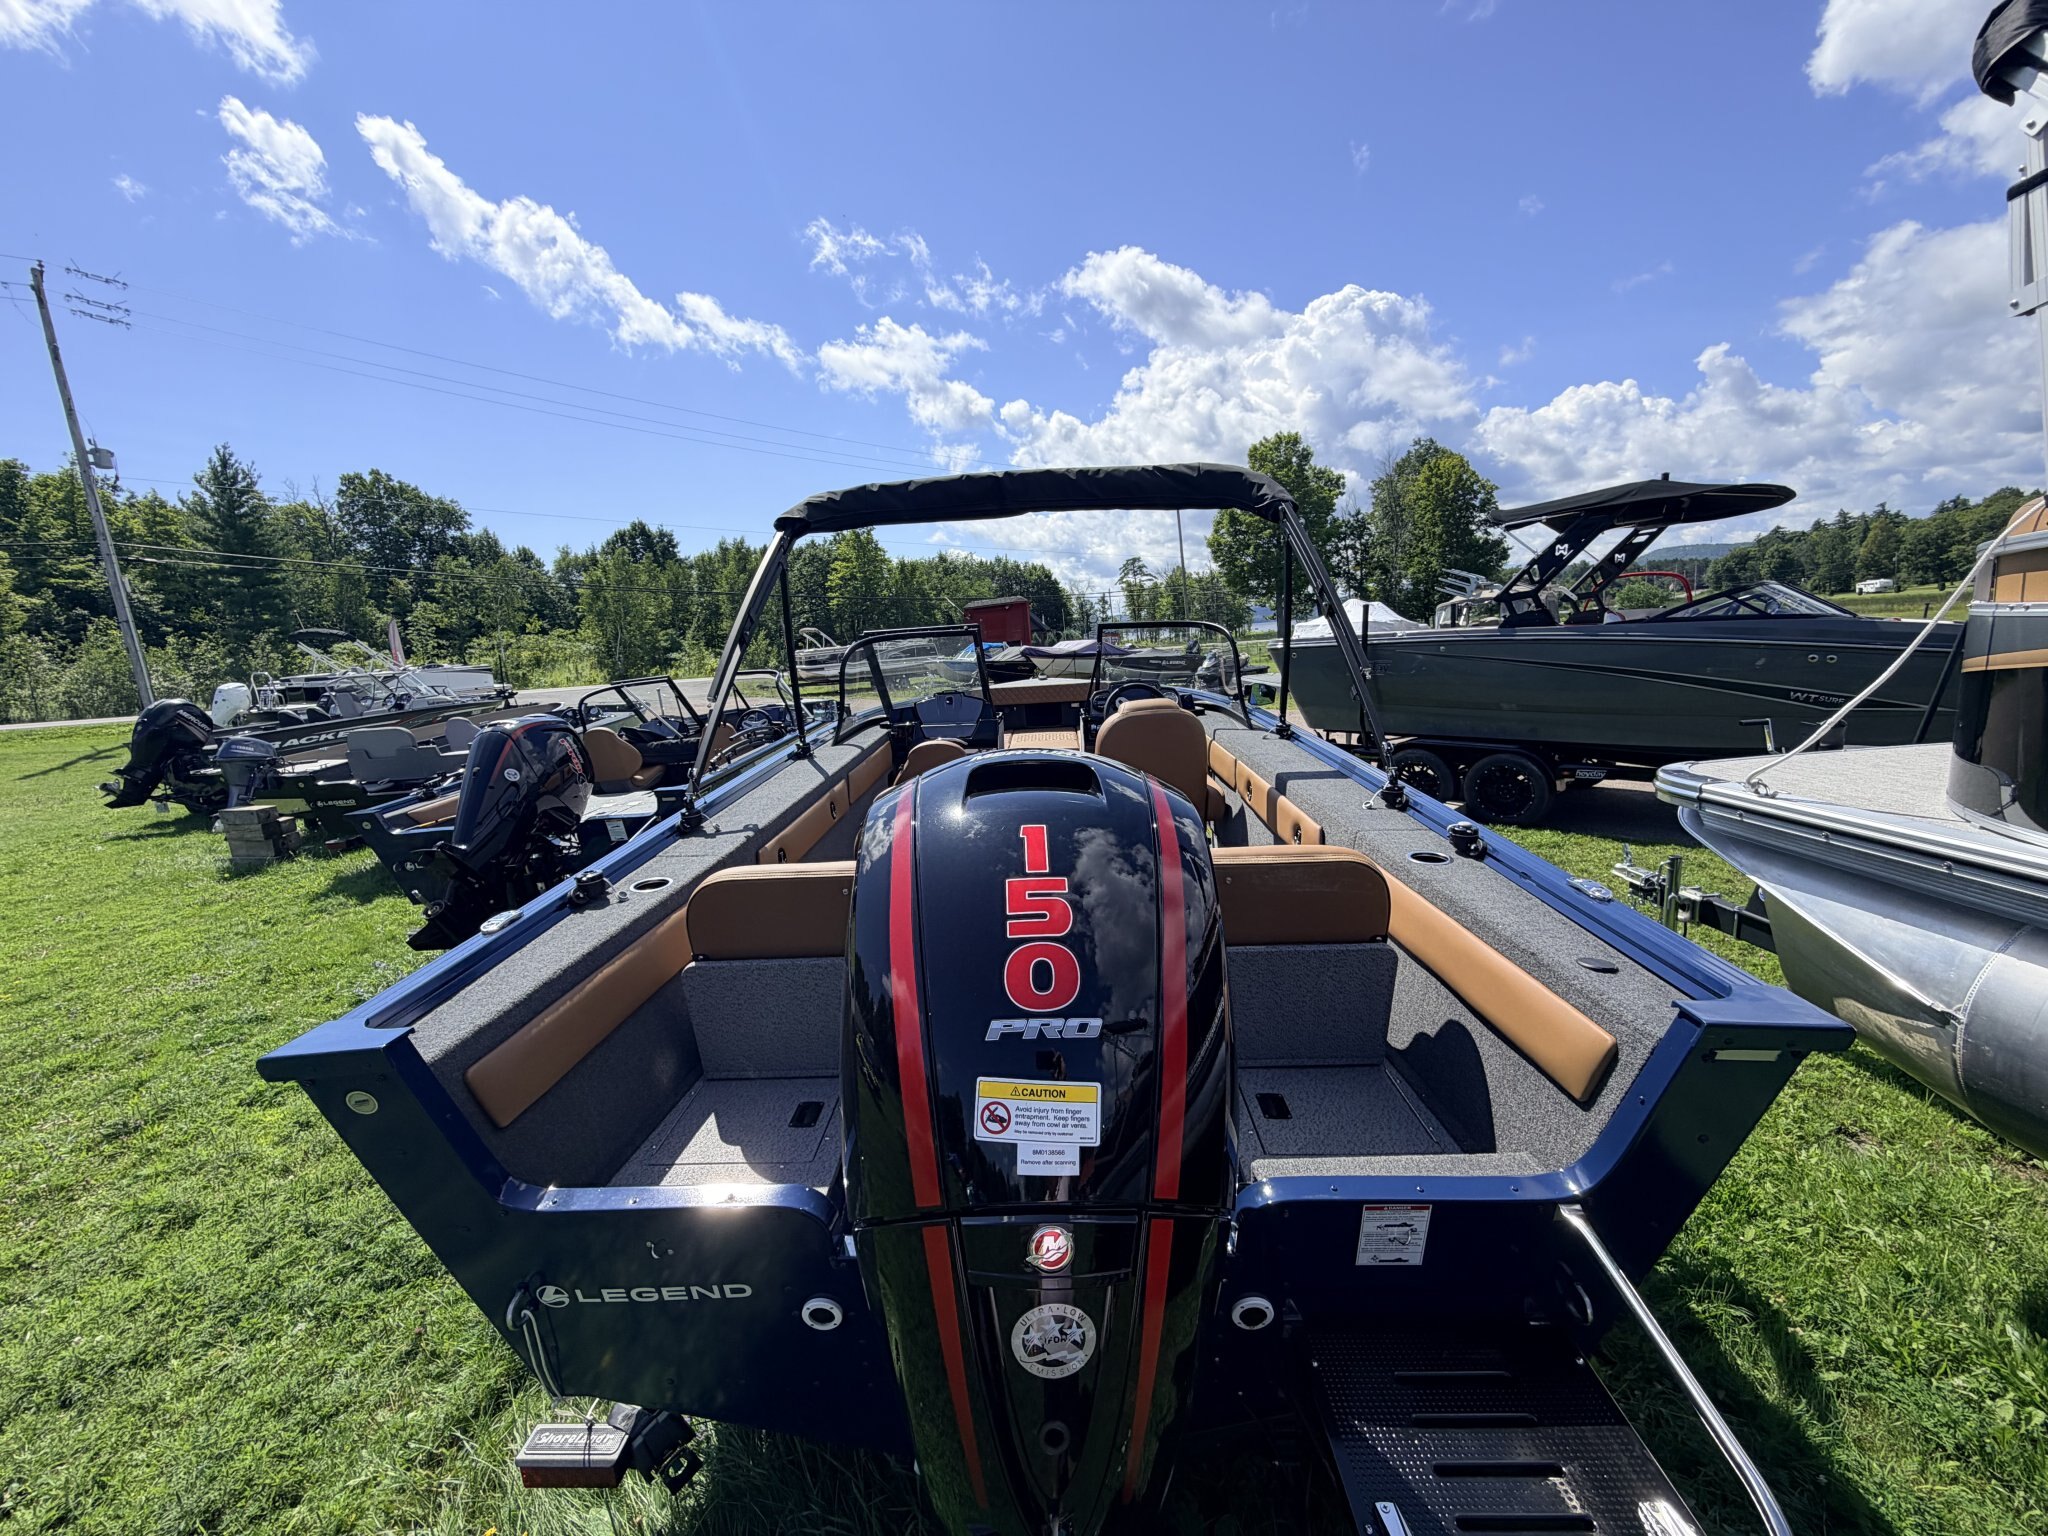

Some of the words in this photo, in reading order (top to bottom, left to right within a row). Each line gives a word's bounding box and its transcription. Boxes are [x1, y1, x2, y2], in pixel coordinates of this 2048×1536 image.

[1004, 824, 1080, 1012] 150
[985, 1017, 1103, 1041] PRO
[1021, 1088, 1066, 1098] CAUTION
[1015, 1105, 1032, 1113] Avoid
[1033, 1106, 1049, 1115] injury
[1065, 1108, 1082, 1116] finger
[1015, 1113, 1051, 1121] entrapment.
[575, 1283, 753, 1303] LEGEND
